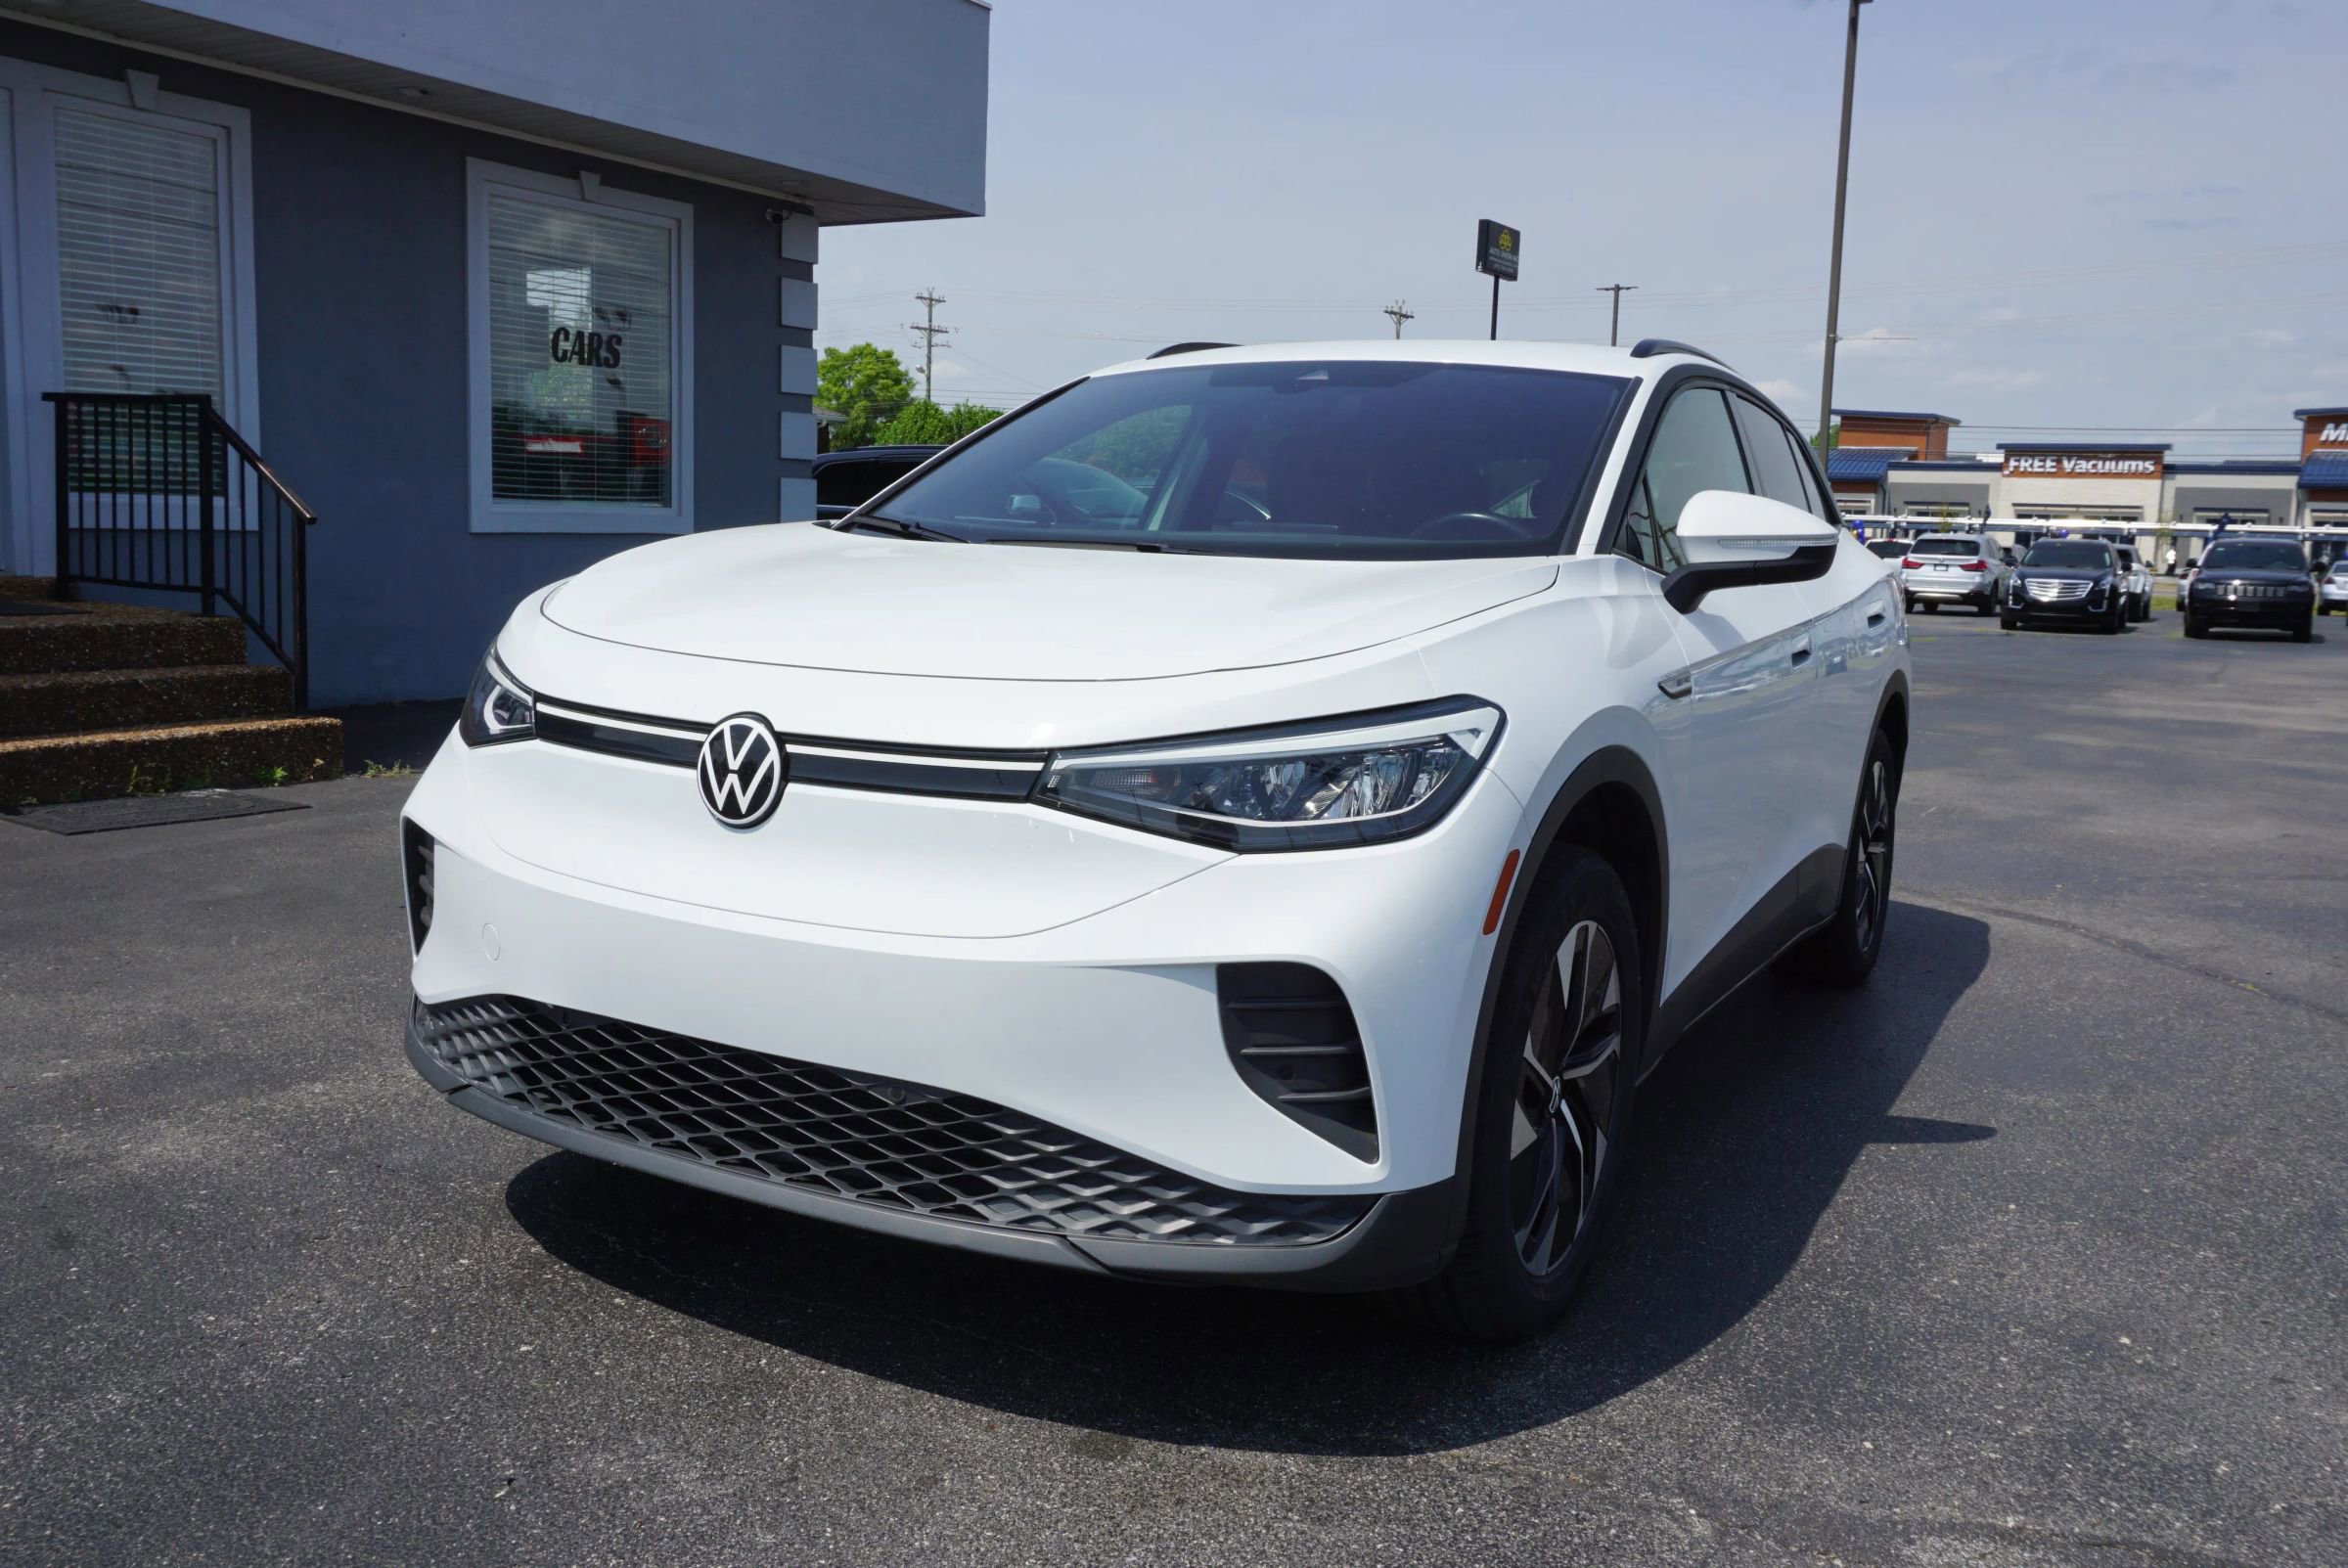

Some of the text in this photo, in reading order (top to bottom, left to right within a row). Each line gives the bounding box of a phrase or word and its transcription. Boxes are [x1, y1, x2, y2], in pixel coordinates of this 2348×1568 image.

[552, 327, 622, 369] CARS
[2319, 423, 2348, 441] M
[2009, 456, 2155, 474] FREE Vacuums
[700, 720, 778, 820] VW
